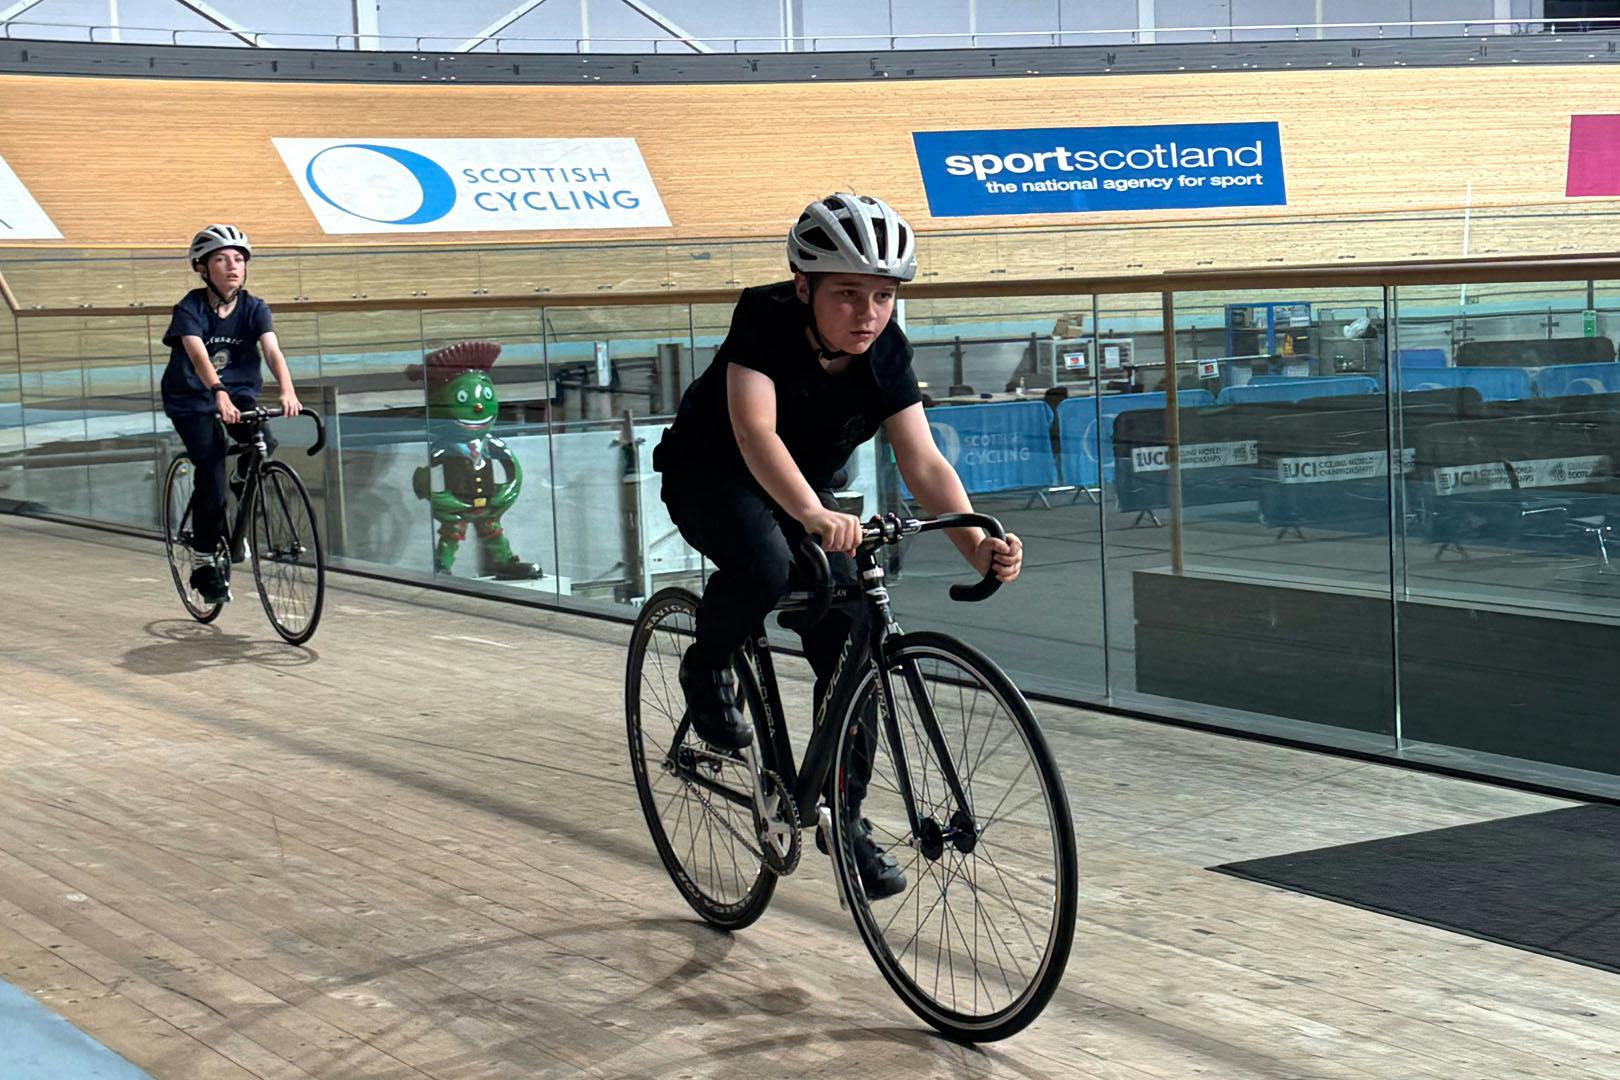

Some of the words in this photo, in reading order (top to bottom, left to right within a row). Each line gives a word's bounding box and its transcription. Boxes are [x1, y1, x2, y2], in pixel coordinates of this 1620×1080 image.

[945, 140, 1263, 180] sportscotland
[463, 167, 611, 184] SCOTTISH
[985, 180, 1017, 194] the
[1022, 177, 1098, 192] national
[1103, 176, 1173, 191] agency
[1177, 174, 1205, 187] for
[1209, 173, 1263, 188] sport
[473, 190, 640, 212] CYCLING
[816, 632, 853, 727] DOLAN
